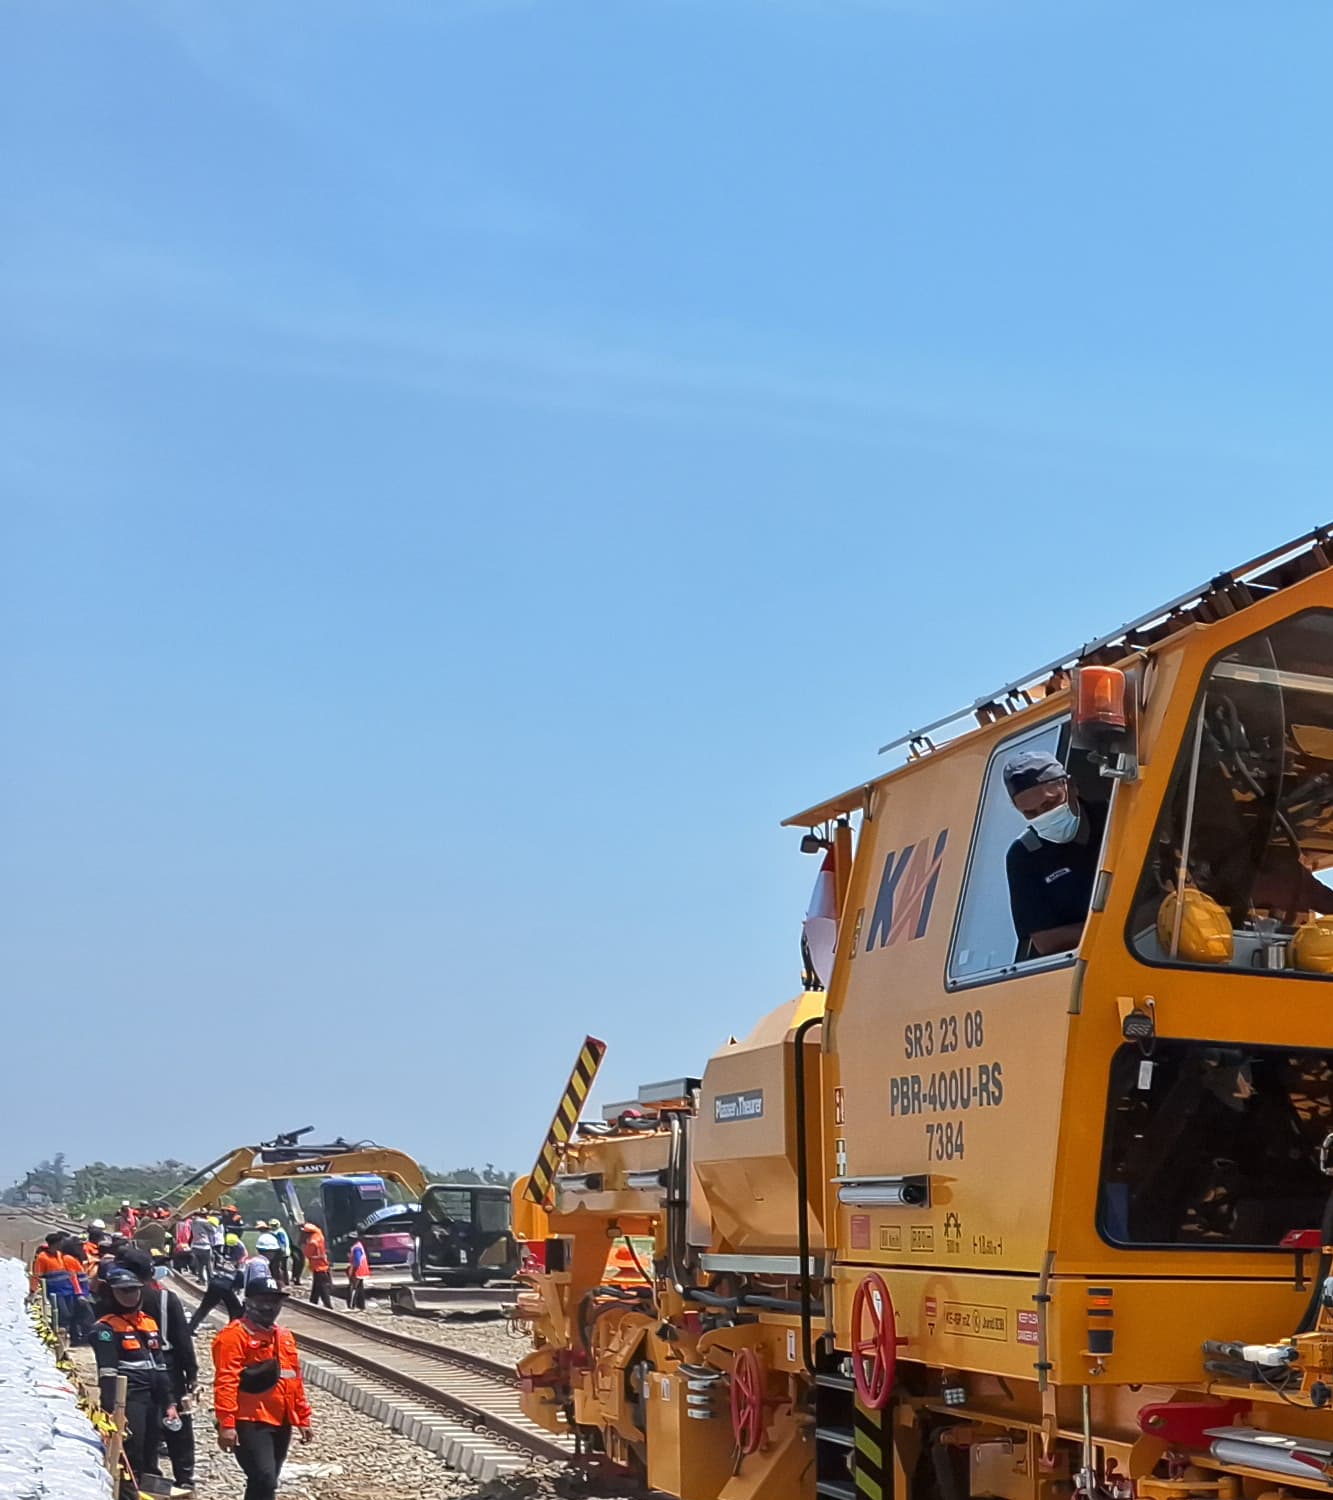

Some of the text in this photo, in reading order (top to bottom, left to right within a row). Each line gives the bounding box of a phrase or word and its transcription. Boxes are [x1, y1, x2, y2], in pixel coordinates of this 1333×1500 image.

[905, 1010, 983, 1059] SR3 23 08
[890, 1062, 1003, 1116] PBR-400U-RS
[926, 1121, 964, 1161] 7384
[296, 1163, 326, 1173] SANY
